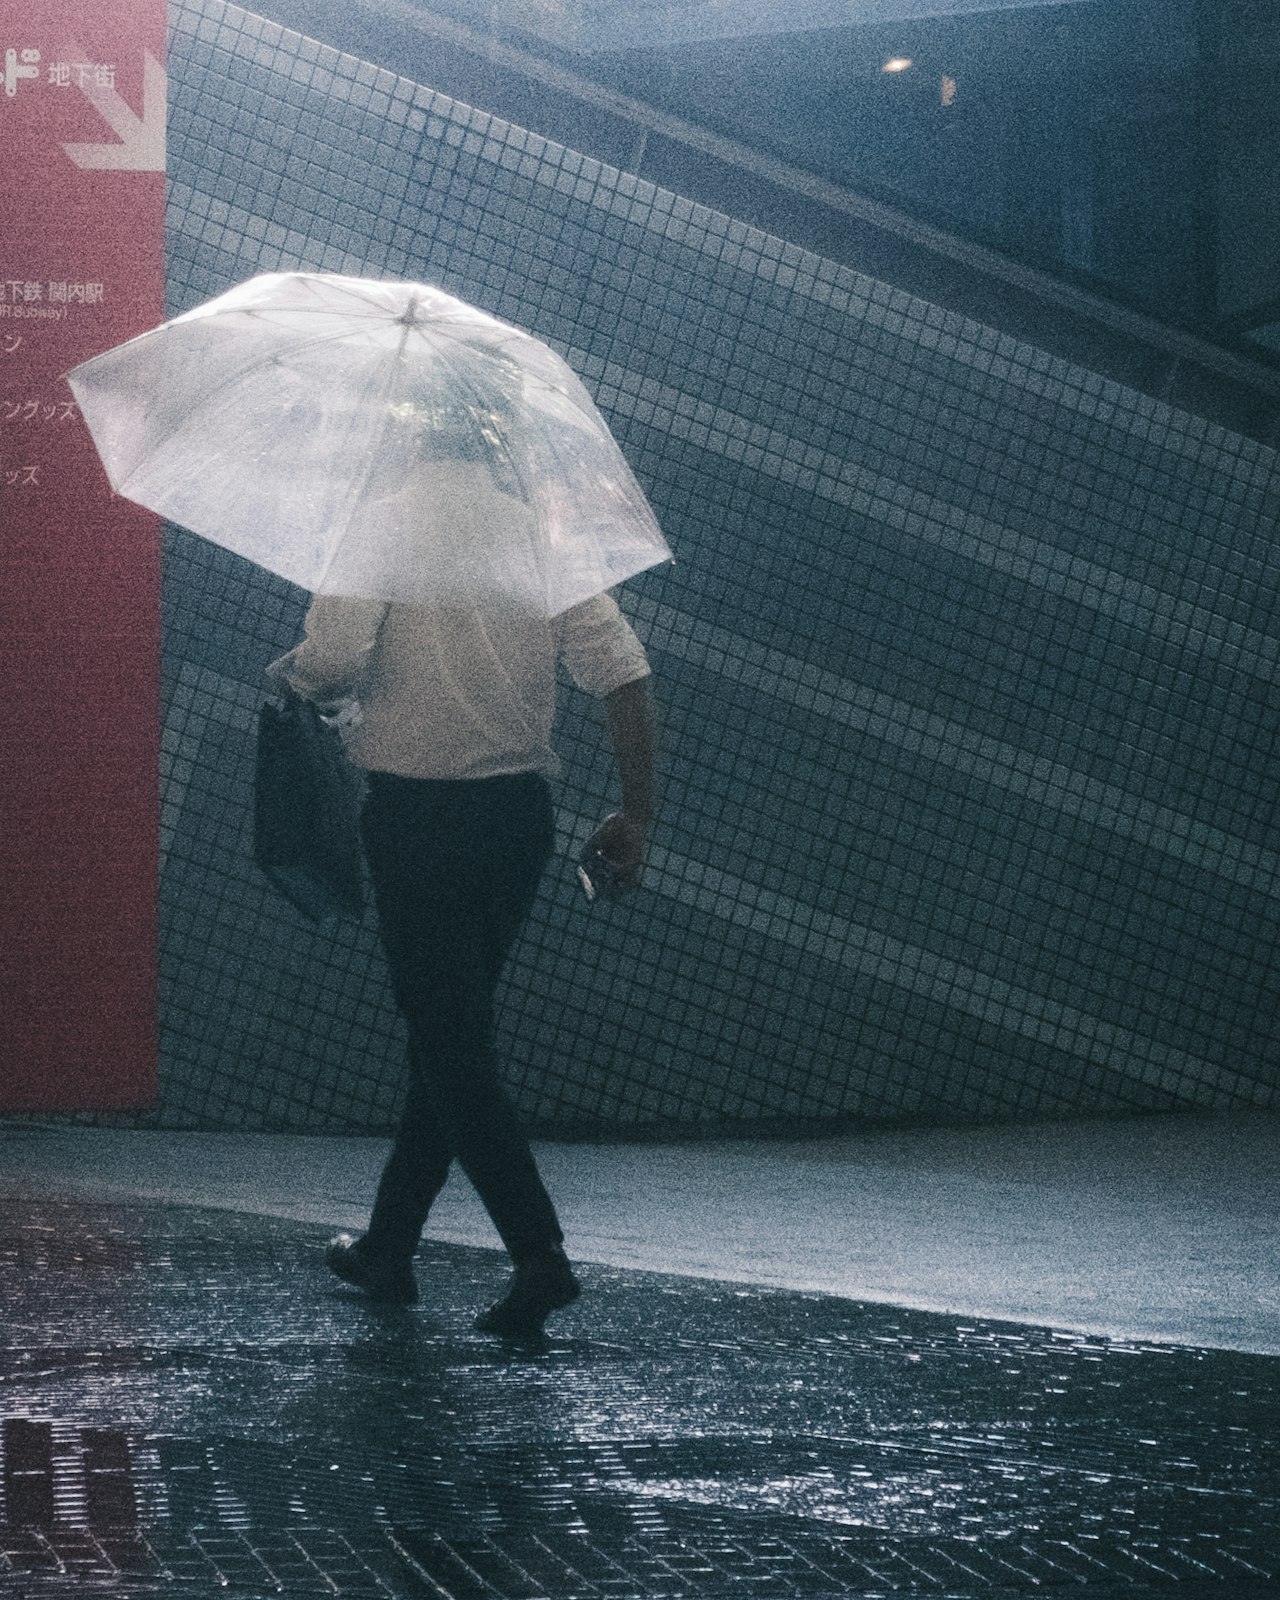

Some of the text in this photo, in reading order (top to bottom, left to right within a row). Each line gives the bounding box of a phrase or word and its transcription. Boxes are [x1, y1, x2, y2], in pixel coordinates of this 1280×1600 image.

[48, 61, 116, 90] 地下街
[48, 281, 105, 304] 関内駅
